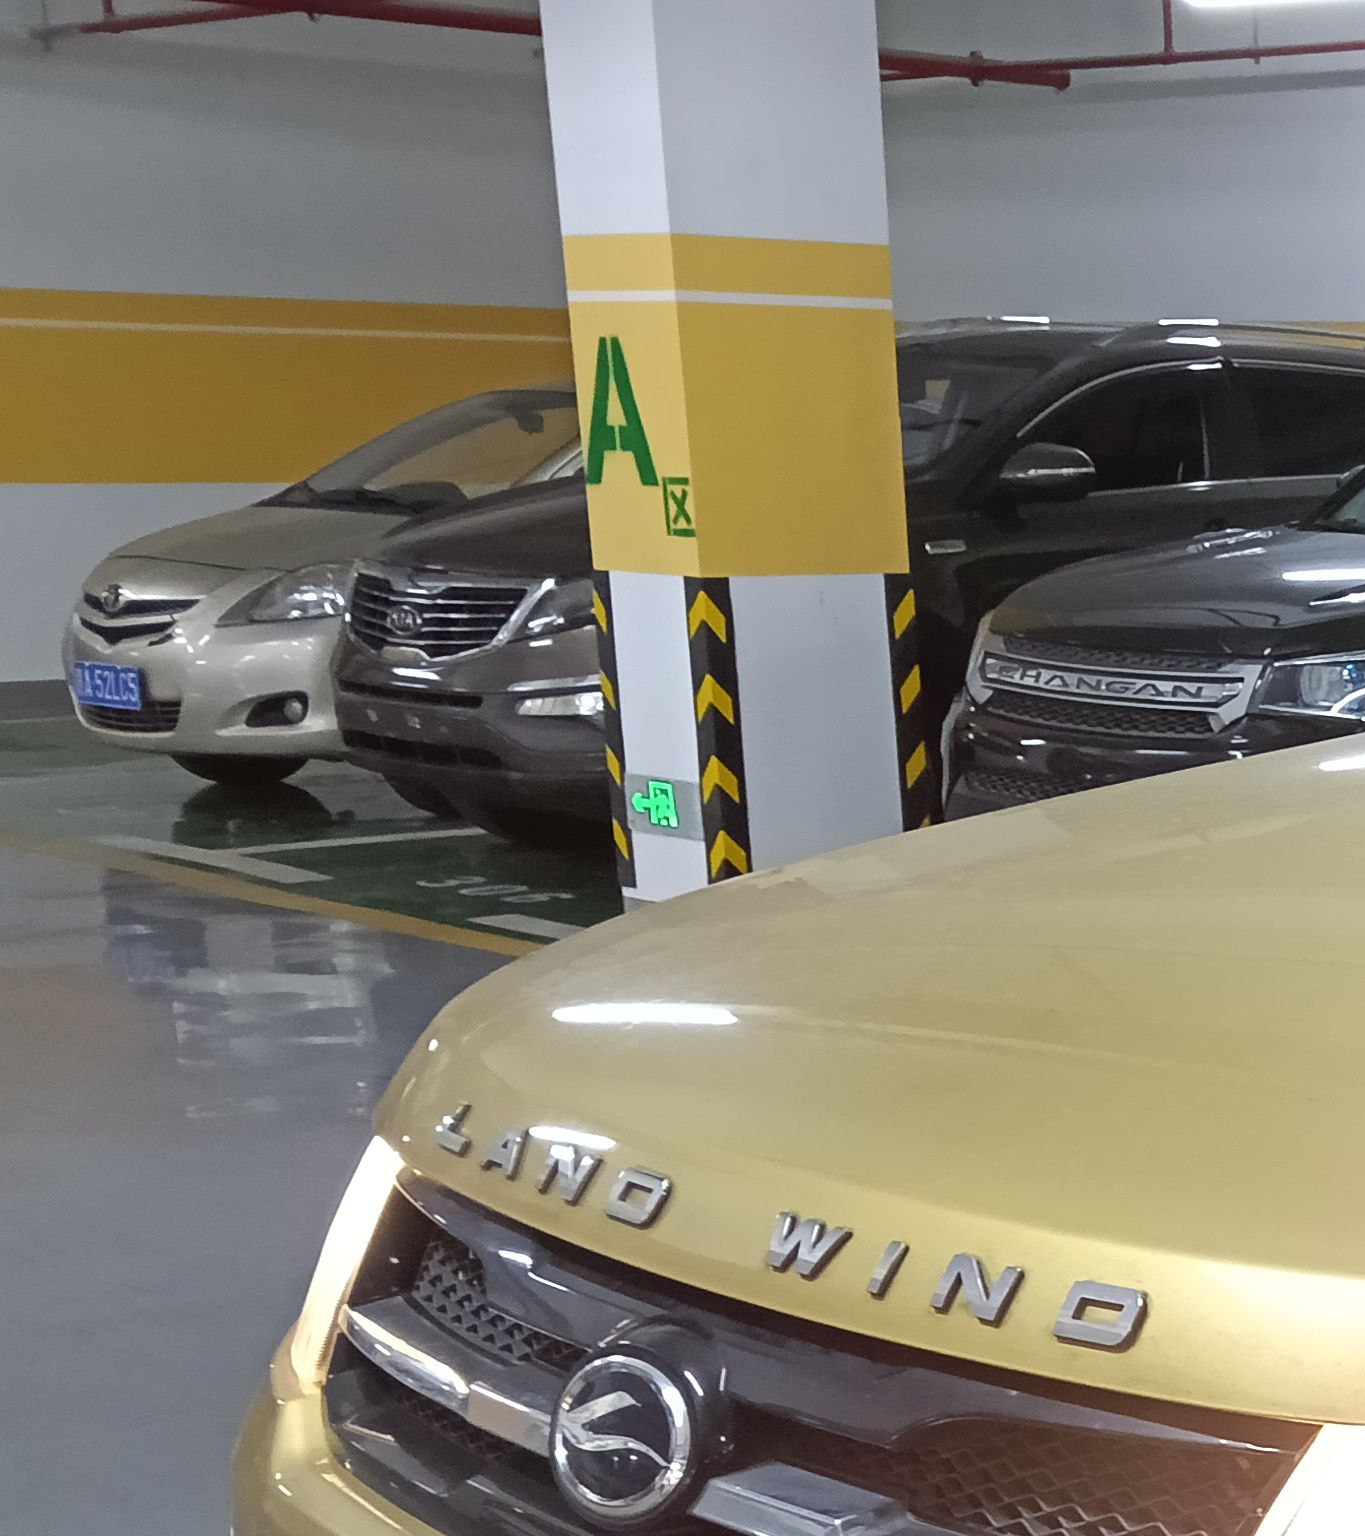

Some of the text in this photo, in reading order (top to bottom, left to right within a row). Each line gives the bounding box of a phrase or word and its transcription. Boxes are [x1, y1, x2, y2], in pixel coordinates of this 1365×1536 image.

[998, 664, 1205, 698] CHANGAN
[434, 1101, 1149, 1354] LAND WIND
